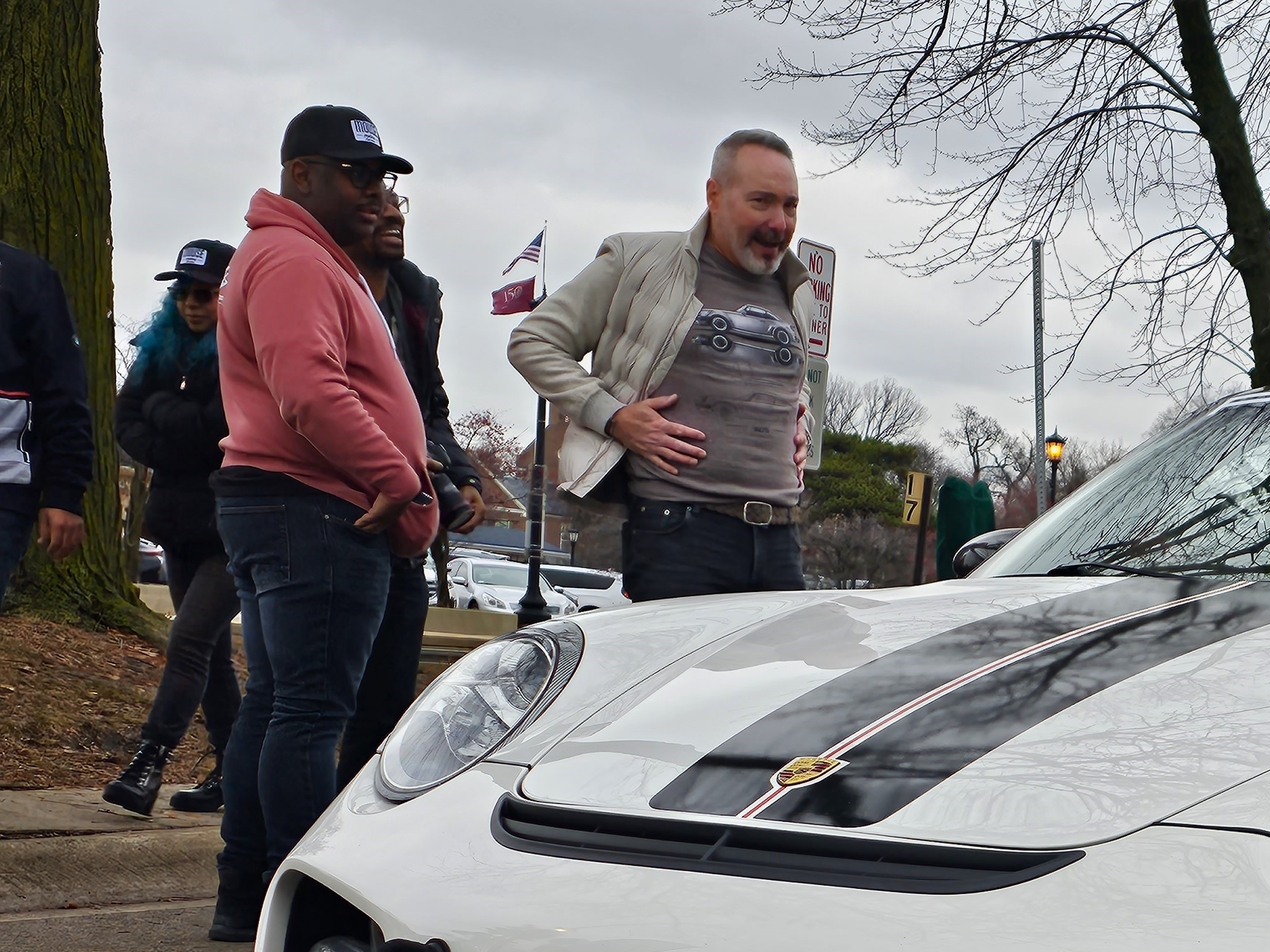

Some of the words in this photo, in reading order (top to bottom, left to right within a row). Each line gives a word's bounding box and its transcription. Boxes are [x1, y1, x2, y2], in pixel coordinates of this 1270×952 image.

[808, 251, 824, 276] NO
[504, 286, 523, 303] 150
[811, 279, 832, 303] KING
[819, 304, 829, 319] TO
[811, 320, 828, 336] NER
[807, 369, 822, 384] NOT
